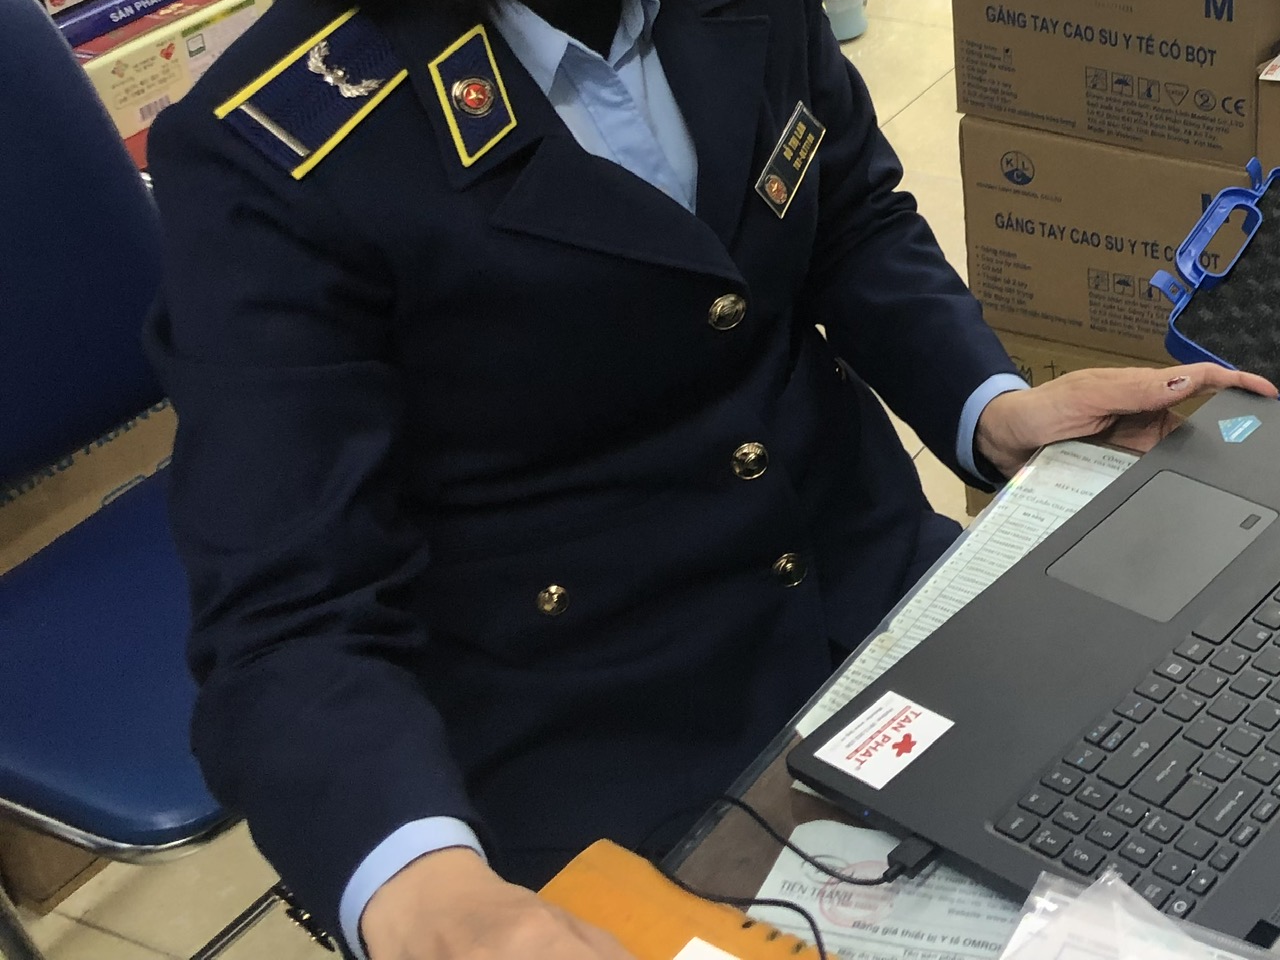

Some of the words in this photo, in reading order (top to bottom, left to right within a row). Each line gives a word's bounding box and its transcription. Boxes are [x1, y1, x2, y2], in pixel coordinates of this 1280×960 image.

[1031, 14, 1059, 35] TAY
[1063, 21, 1094, 42] CAO
[1098, 28, 1119, 47] SU
[1122, 32, 1133, 50] Y
[1159, 38, 1181, 60] CÓ
[1039, 222, 1066, 241] TAY
[1069, 228, 1100, 248] CAO
[1105, 235, 1124, 252] SU
[1128, 239, 1137, 256] Y
[1164, 245, 1177, 262] C
